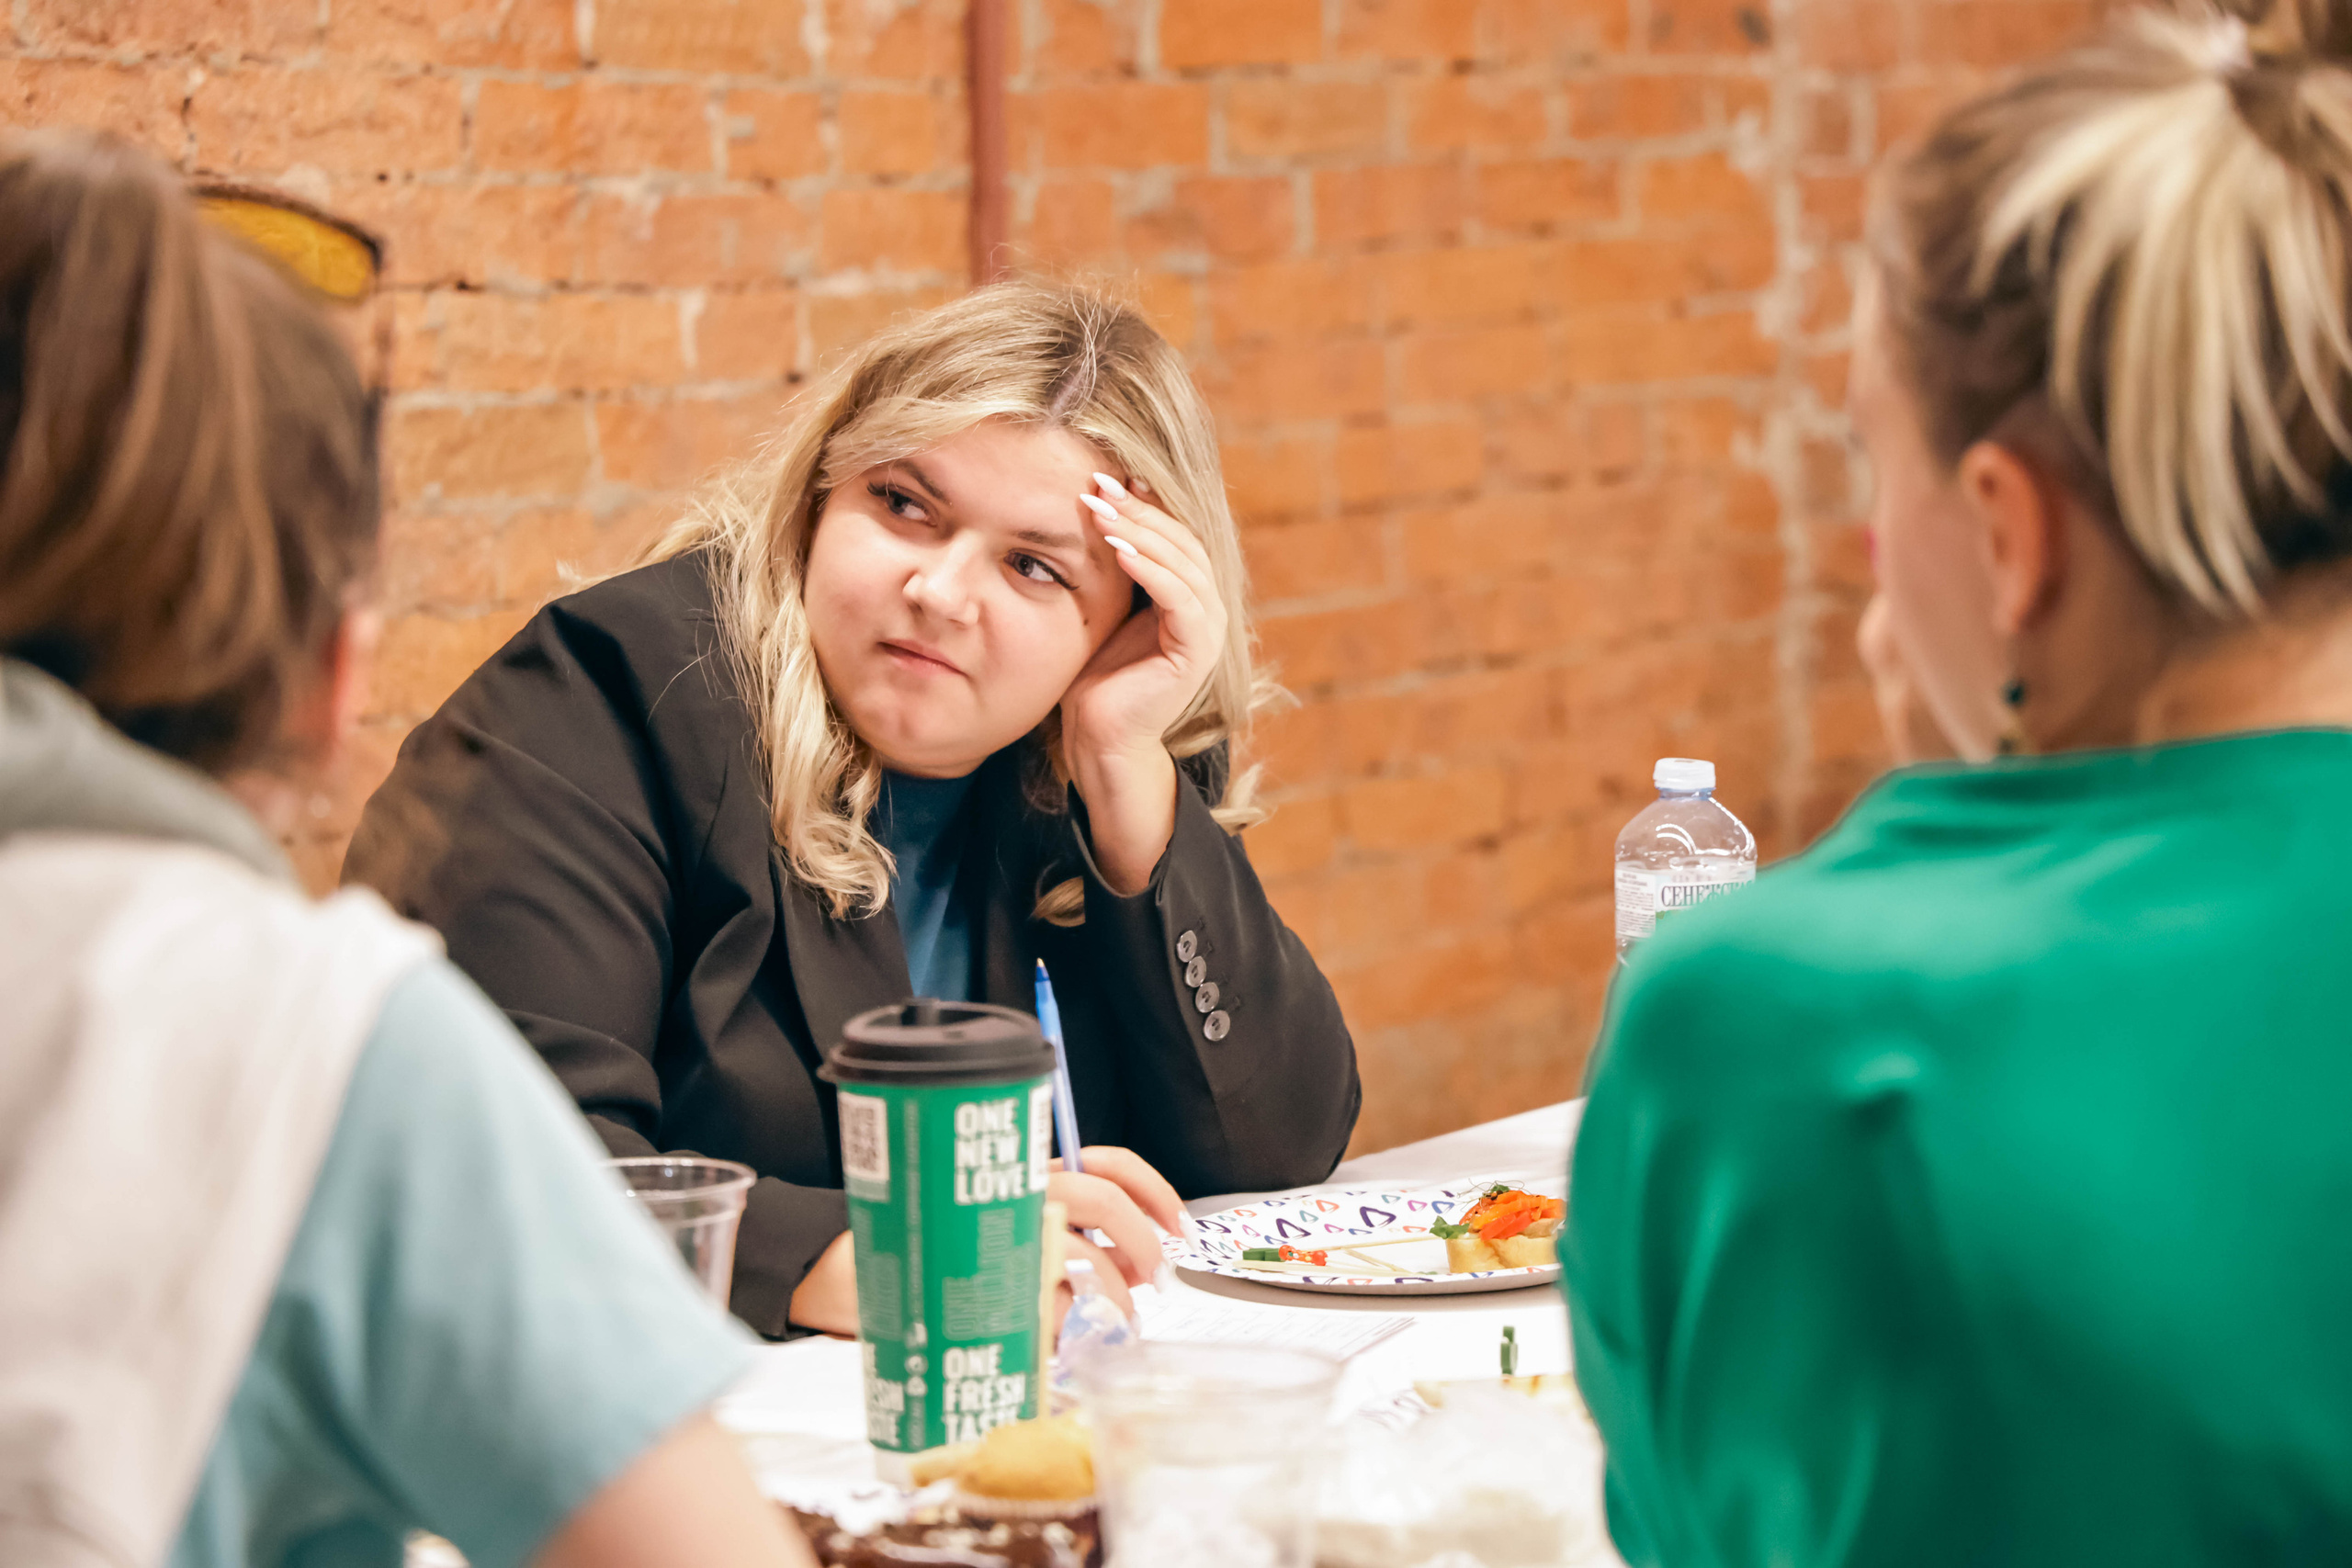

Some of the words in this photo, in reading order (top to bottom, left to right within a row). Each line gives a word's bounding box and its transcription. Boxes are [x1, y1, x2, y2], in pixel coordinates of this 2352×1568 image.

[955, 1098, 1019, 1135] ONE
[954, 1128, 1022, 1169] NEW
[954, 1161, 1027, 1206] LOVE
[943, 1343, 1004, 1379] ONE
[943, 1371, 1026, 1413] FRESH
